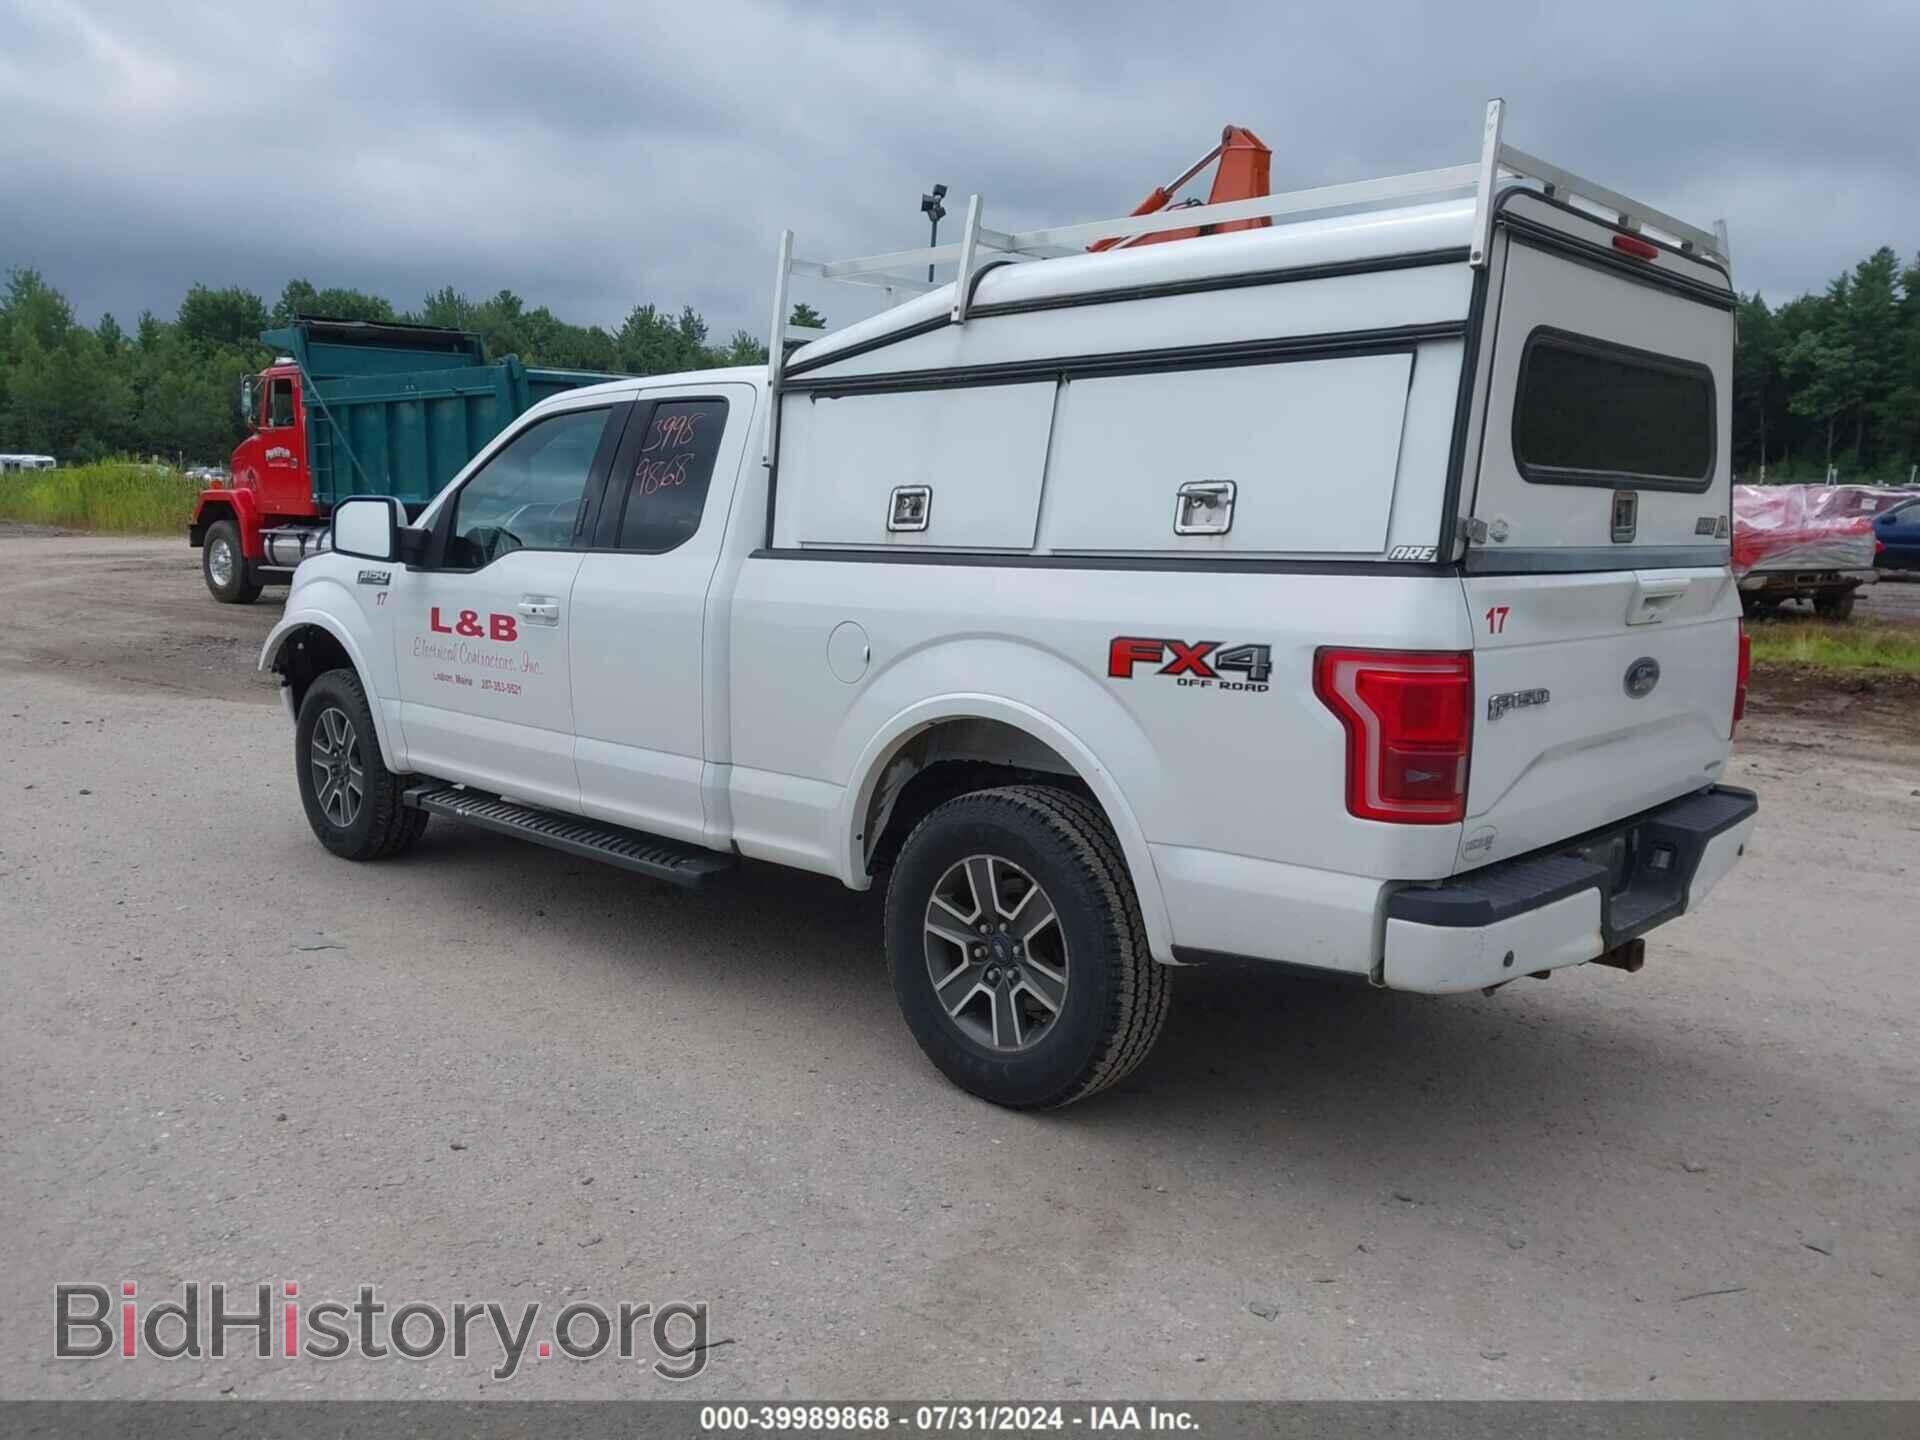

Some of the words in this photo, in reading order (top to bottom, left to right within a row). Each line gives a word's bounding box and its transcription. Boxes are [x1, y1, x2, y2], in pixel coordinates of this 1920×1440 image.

[377, 591, 387, 606] 17
[430, 606, 518, 641] L&B
[1486, 606, 1510, 634] 17
[1108, 636, 1271, 682] FX4
[1177, 678, 1213, 687] OFF
[1219, 681, 1269, 692] ROAD
